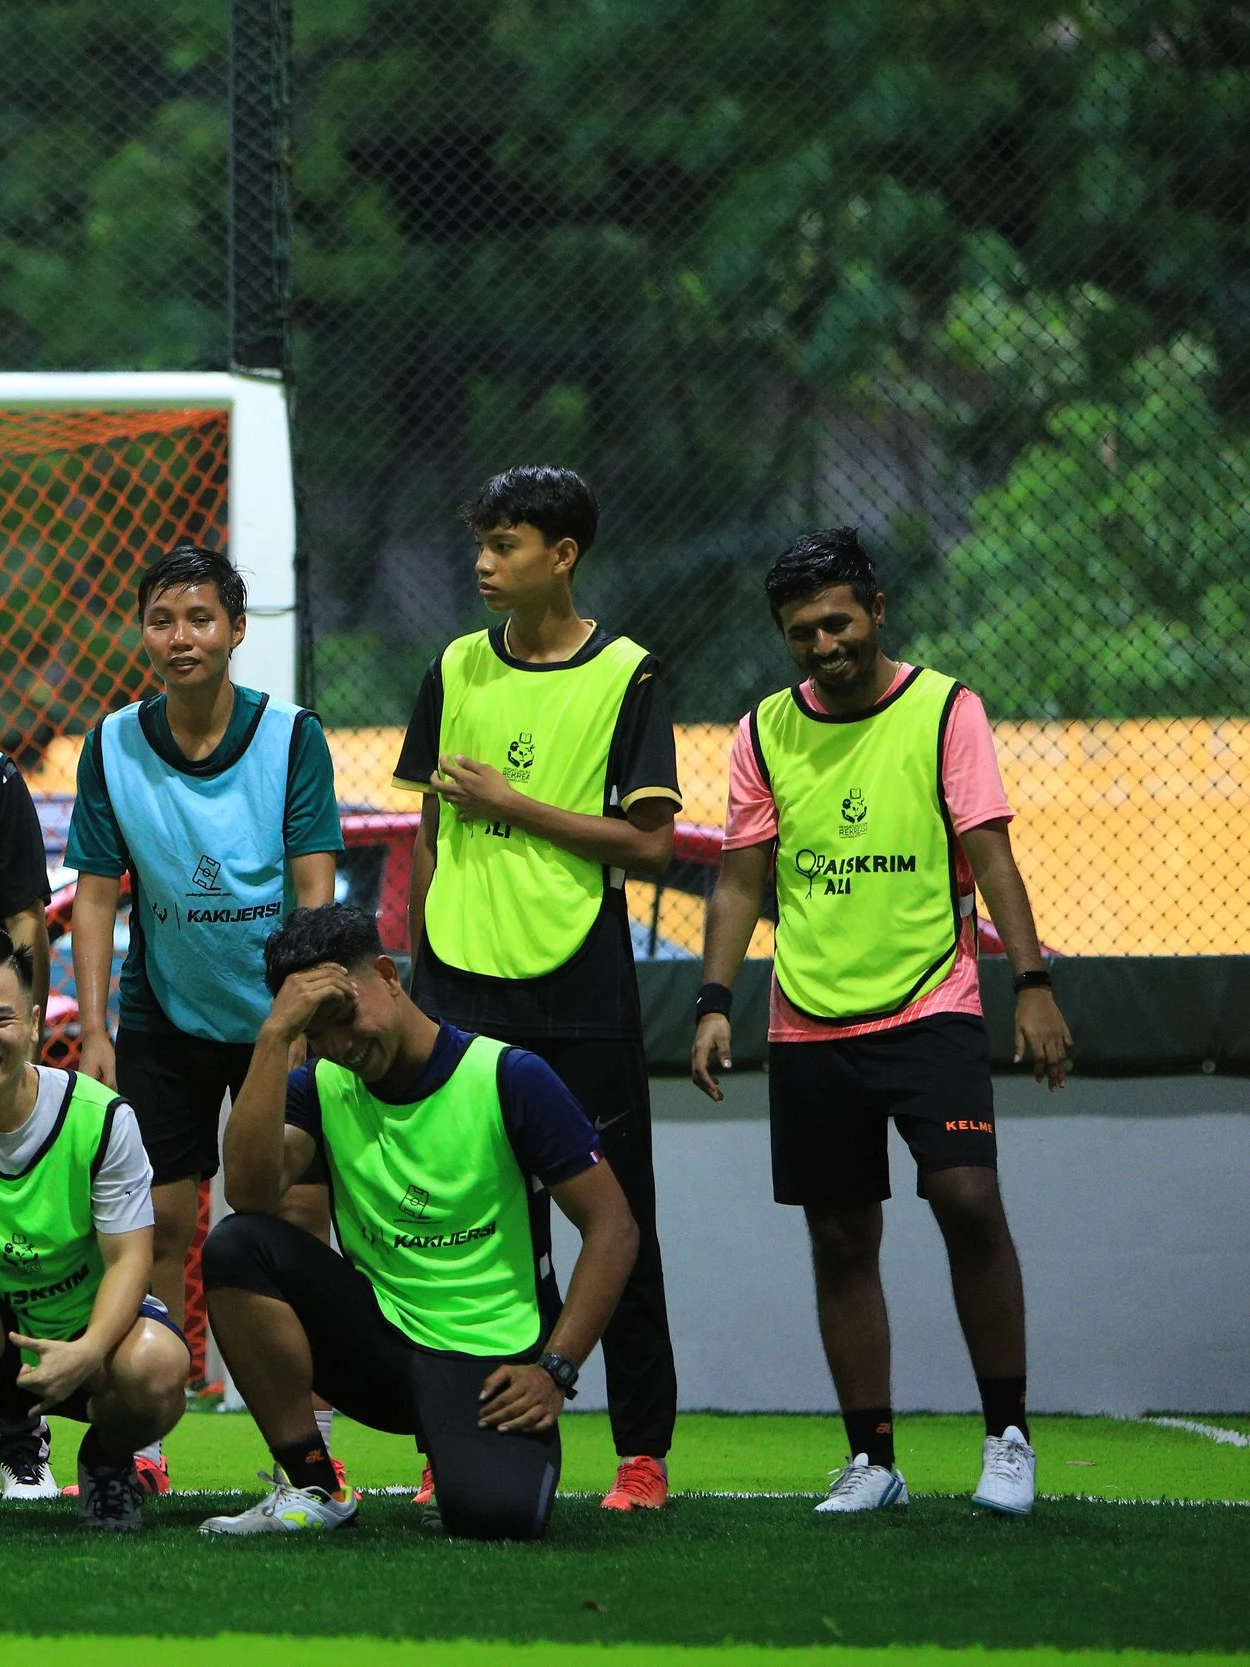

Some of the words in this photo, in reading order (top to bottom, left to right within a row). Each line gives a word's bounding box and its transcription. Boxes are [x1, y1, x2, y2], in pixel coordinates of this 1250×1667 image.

[822, 855, 916, 875] AISKRIM
[824, 877, 851, 895] ALI
[187, 901, 282, 923] KAKIJERSI
[945, 1120, 993, 1134] KELME
[394, 1221, 497, 1249] KAKIJERSI
